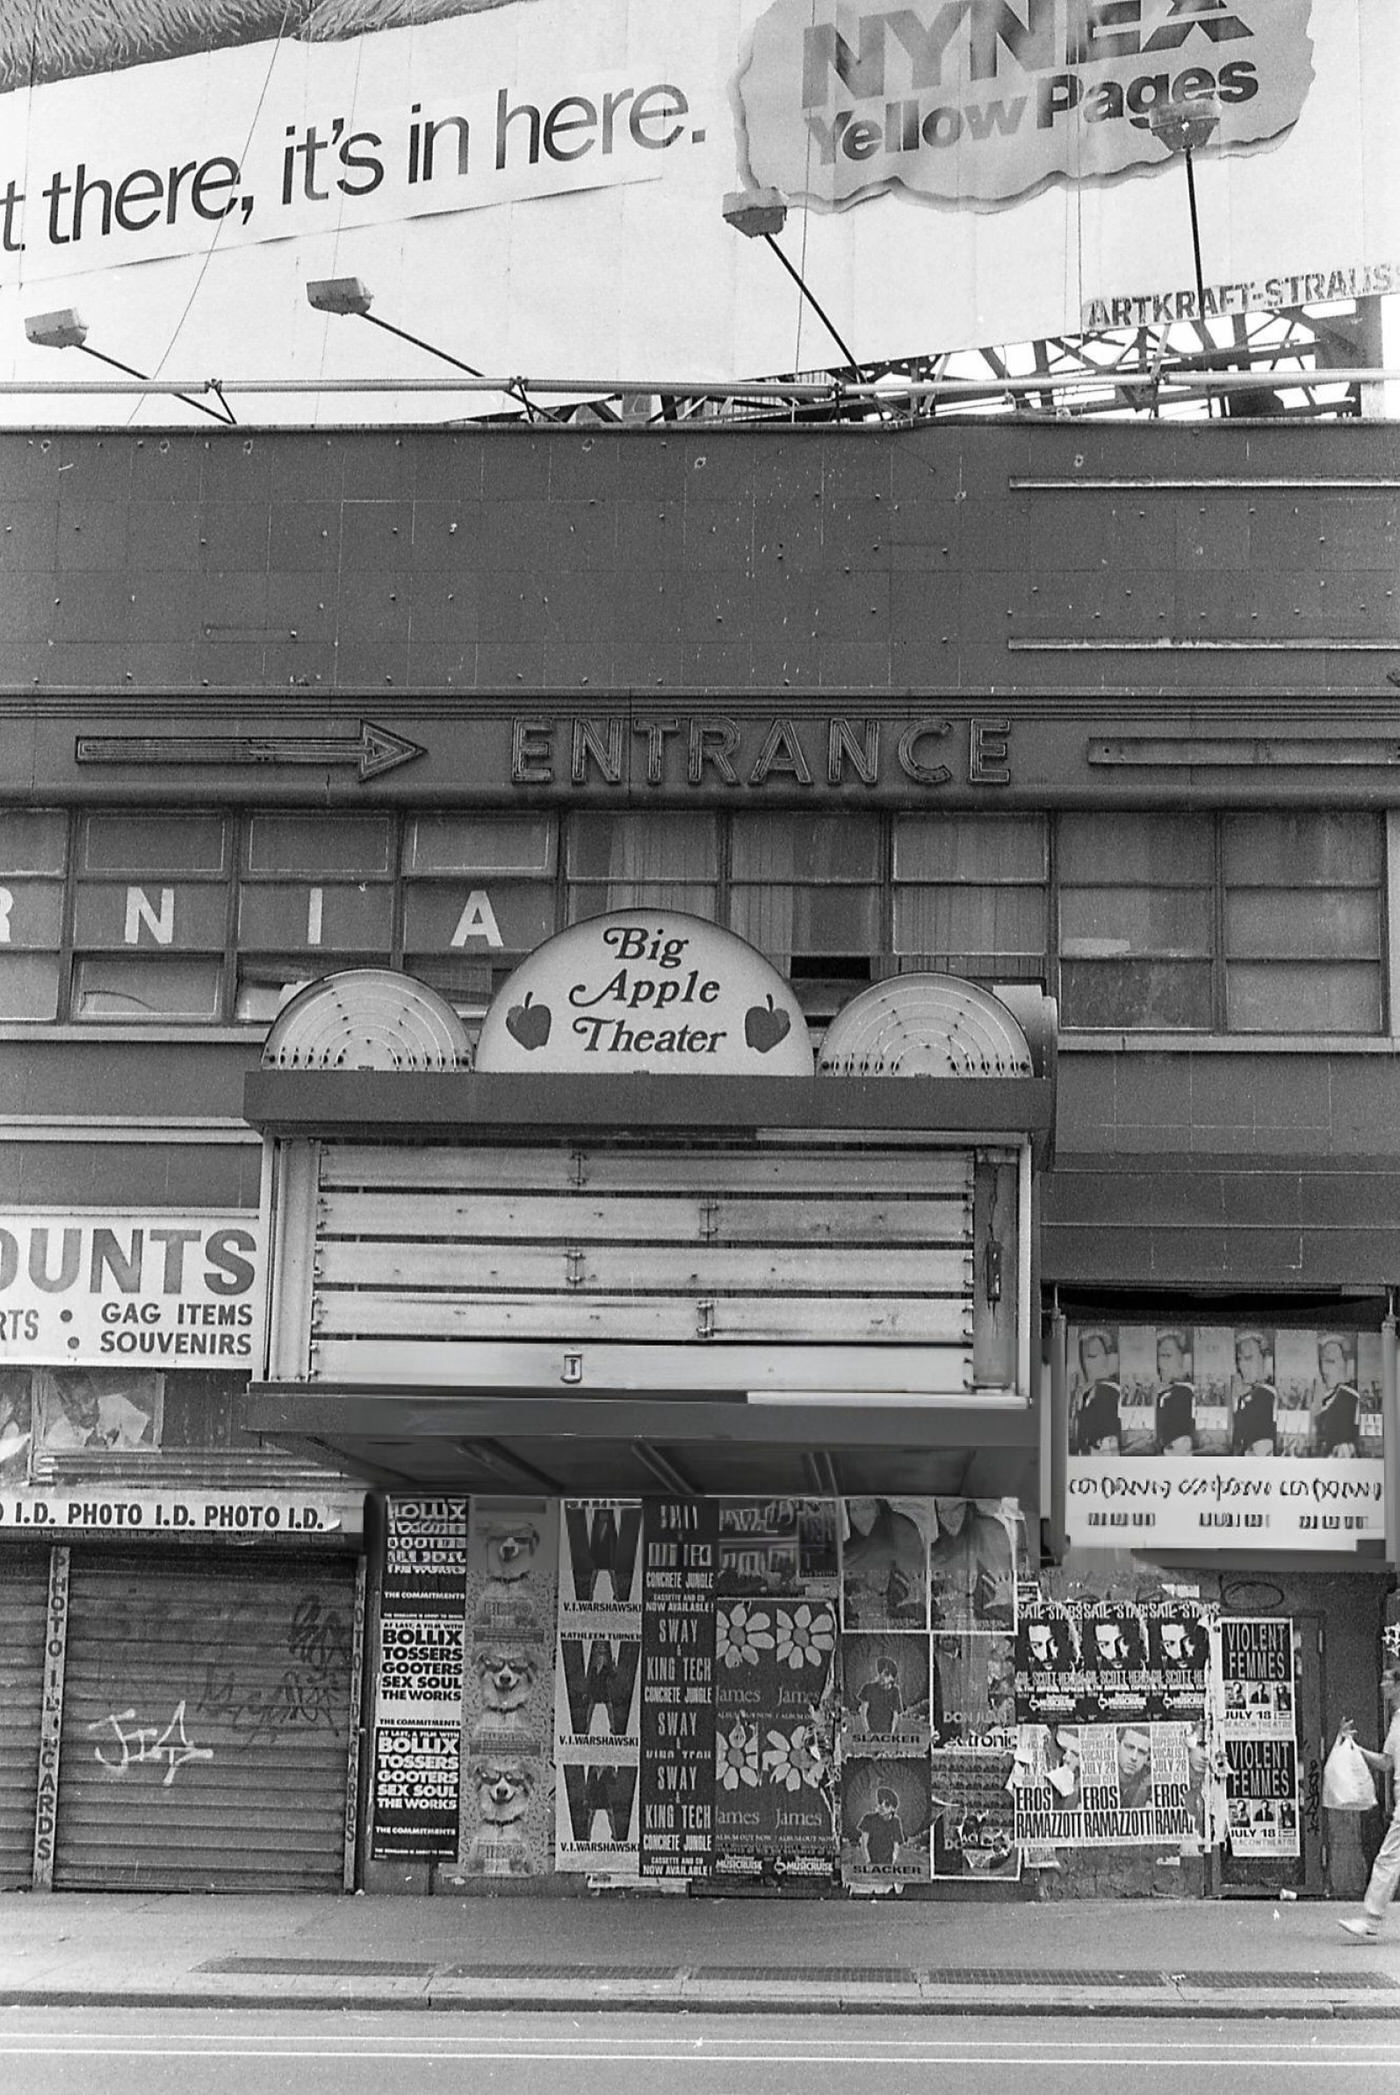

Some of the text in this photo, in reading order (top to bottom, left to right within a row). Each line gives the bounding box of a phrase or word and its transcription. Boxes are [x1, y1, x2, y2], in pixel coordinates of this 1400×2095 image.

[803, 0, 1255, 107] NYNEX
[803, 60, 1259, 165] Yellow Pages
[42, 157, 255, 245] there,
[281, 117, 384, 206] it's
[408, 103, 470, 183] in
[495, 82, 706, 171] here.
[1088, 260, 1400, 327] ARTKRAFT-STRAUS
[511, 717, 1011, 785] ENTRANCE
[603, 926, 689, 967] Big
[568, 969, 720, 1011] Apple
[572, 1015, 727, 1055] Theater
[101, 1302, 161, 1324] GAG
[178, 1303, 253, 1326] ITEMS
[100, 1331, 252, 1356] SOUVENIRS
[15, 1503, 56, 1525] I.D.
[68, 1503, 143, 1526] PHOTO
[155, 1504, 196, 1527] I.D.
[204, 1505, 280, 1528] PHOTO
[288, 1507, 324, 1529] I.D.
[384, 1591, 400, 1599] THE
[645, 1602, 667, 1611] NOW
[382, 1629, 462, 1646] BOLLIX
[659, 1618, 698, 1643] SWAY
[1226, 1625, 1285, 1651] VIOLENT
[382, 1646, 463, 1661] TOSSERS
[1229, 1652, 1285, 1679] FEMMES
[381, 1662, 463, 1675] GOOTERS
[647, 1656, 711, 1682] KING TECH
[382, 1676, 462, 1689] SEX SOUL
[382, 1690, 461, 1701] THE WORKS
[658, 1711, 697, 1736] SWAY
[1225, 1711, 1252, 1720] JULY
[1257, 1711, 1271, 1720] 18
[378, 1737, 458, 1754] BOLLIX
[852, 1733, 920, 1744] SLACKER
[378, 1754, 459, 1769] TOSSERS
[1230, 1742, 1289, 1769] VIOLENT
[377, 1770, 459, 1784] GOOTERS
[658, 1766, 697, 1790] SWAY
[1233, 1769, 1290, 1796] FEMMES
[377, 1784, 458, 1798] SEX SOUL
[1015, 1787, 1052, 1812] EROS
[1083, 1785, 1119, 1810] EROS
[1154, 1783, 1188, 1808] EROS
[37, 1750, 56, 1861] CARDS
[377, 1798, 457, 1810] THE WORKS
[645, 1804, 711, 1829] KING TECH
[375, 1826, 391, 1834] THE
[775, 1807, 822, 1829] James
[1084, 1810, 1154, 1838] RAMAZZOTTI
[1231, 1829, 1276, 1838] JULY 18
[643, 1865, 664, 1875] NOW
[853, 1864, 921, 1875] SLACKER
